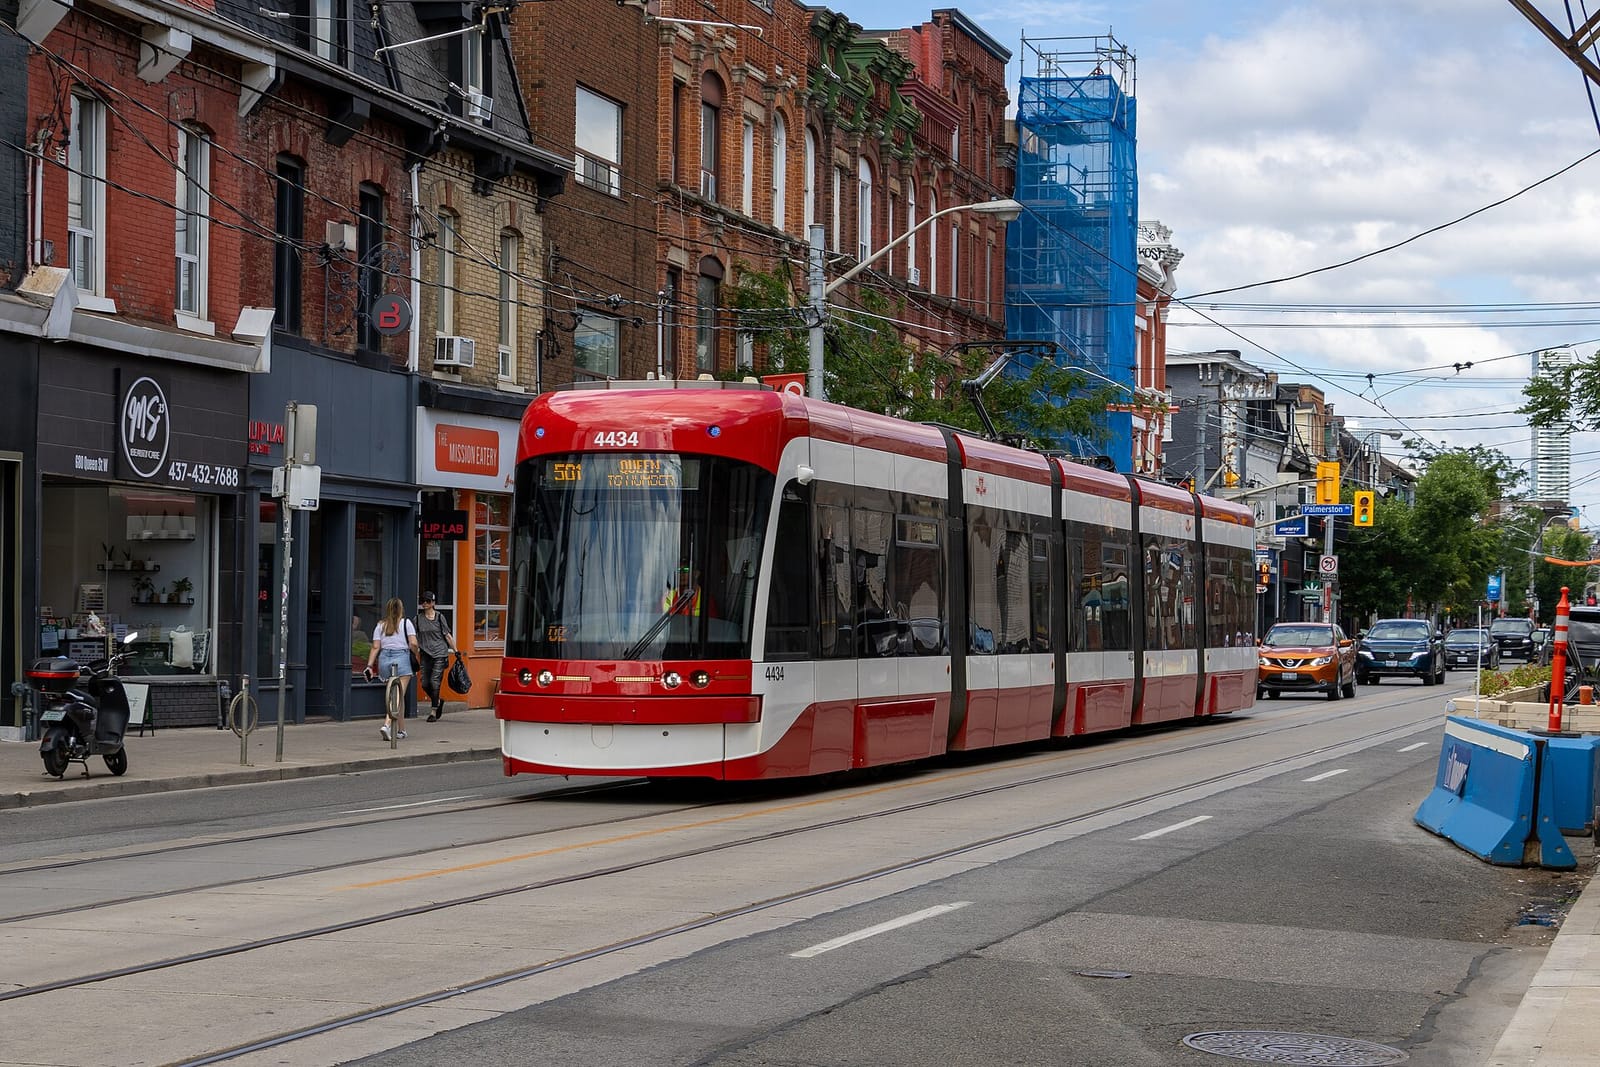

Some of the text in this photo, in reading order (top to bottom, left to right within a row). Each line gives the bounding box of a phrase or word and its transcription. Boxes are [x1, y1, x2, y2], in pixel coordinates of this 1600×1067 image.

[438, 431, 448, 447] THE
[594, 431, 639, 447] 4434
[449, 443, 497, 467] MISSION EATERY
[168, 461, 239, 487] 437-432-7688
[554, 463, 582, 481] 501
[620, 459, 660, 474] QUEEN
[608, 474, 623, 487] TO
[1304, 505, 1343, 513] Palmerston
[423, 523, 464, 534] LIP LAB
[765, 665, 785, 681] 4434
